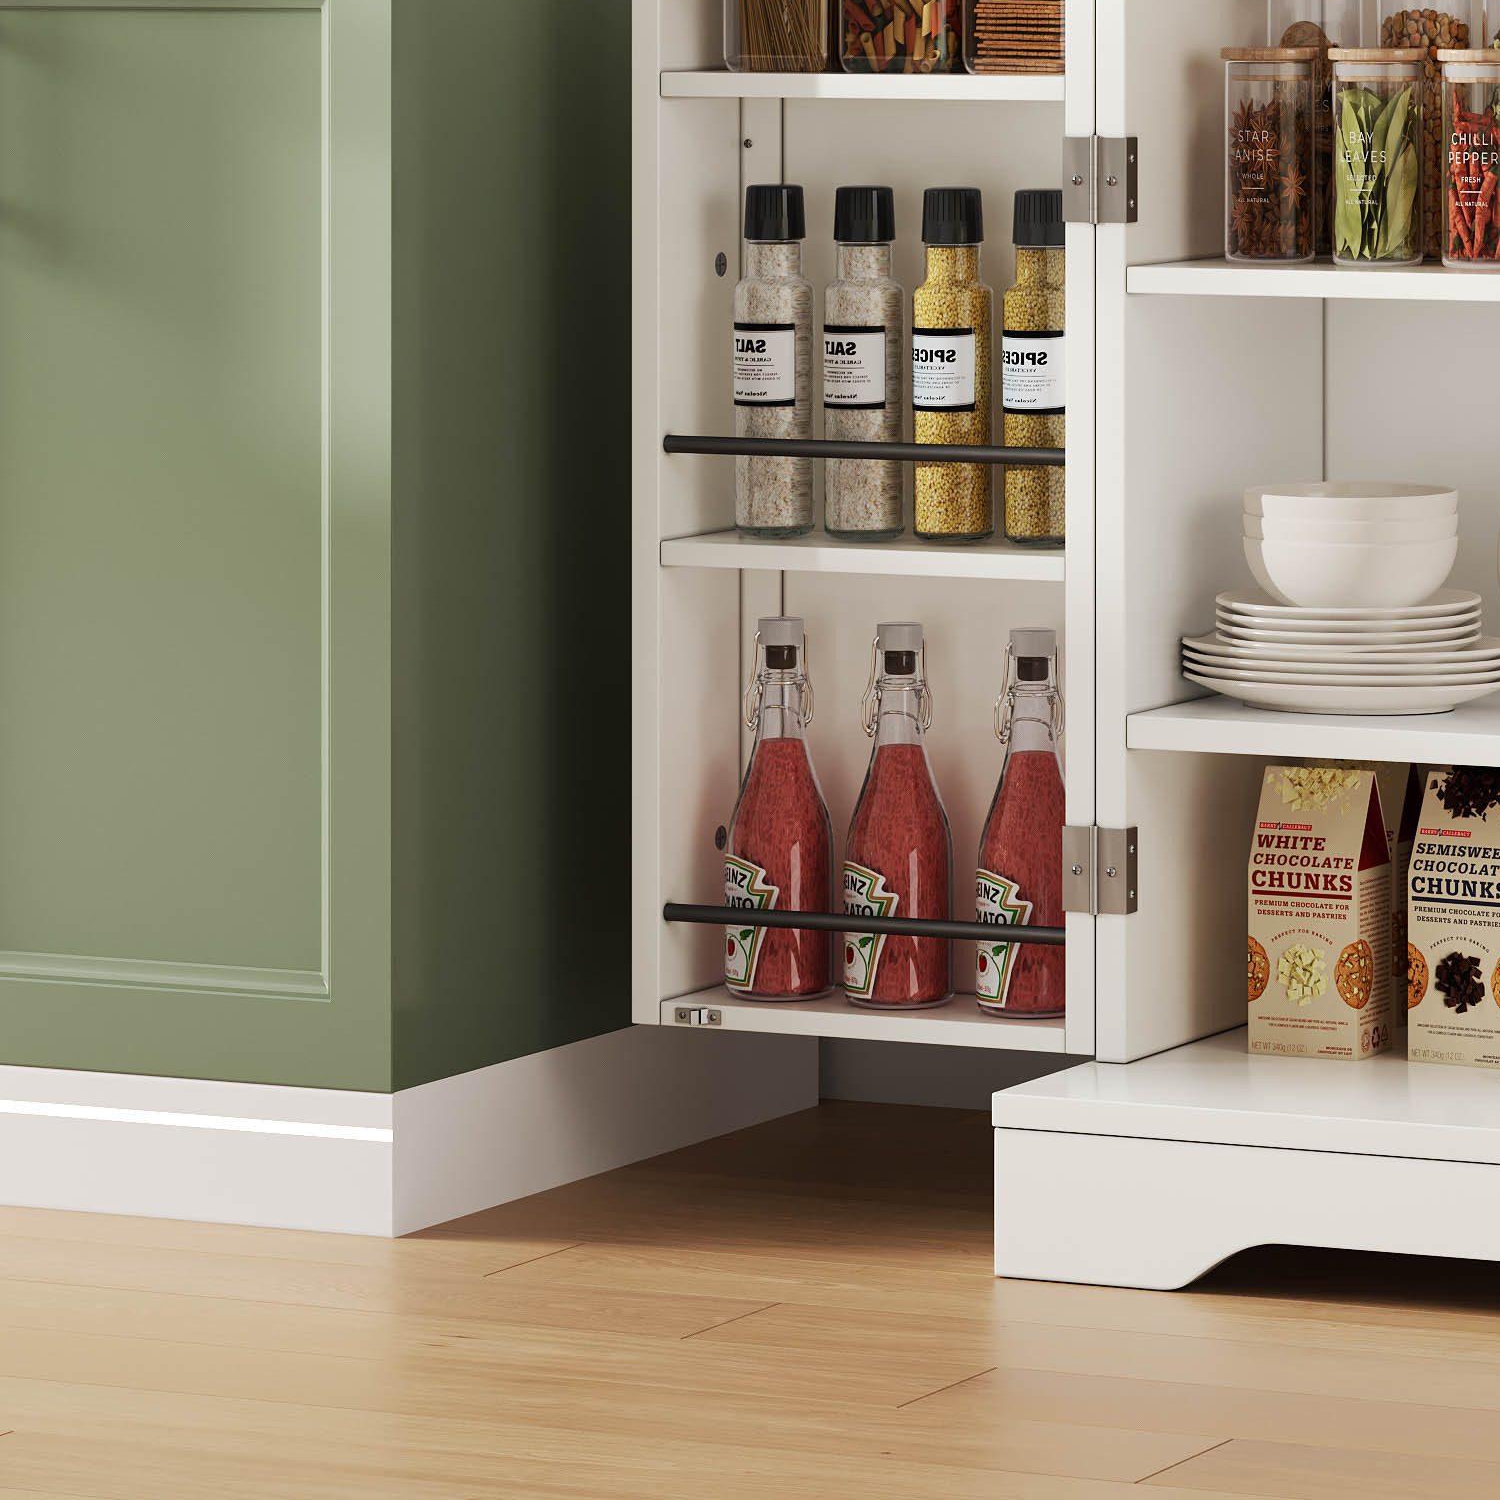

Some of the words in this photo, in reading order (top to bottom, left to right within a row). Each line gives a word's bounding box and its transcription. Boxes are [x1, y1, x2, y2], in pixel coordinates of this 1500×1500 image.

[1238, 130, 1269, 143] STAR
[1349, 132, 1374, 144] BAY
[1451, 133, 1493, 146] CHILLI
[1235, 149, 1274, 162] ANISE
[1340, 150, 1387, 163] LEAVES
[1448, 152, 1499, 165] PEPPER
[1257, 834, 1326, 852] WHITE
[1253, 853, 1355, 870] CHOCOLATE
[843, 873, 867, 896] EINZ
[1251, 870, 1353, 893] CHUNKS
[975, 881, 1001, 904] EINZ
[1254, 899, 1289, 908] PREMIUM
[1290, 901, 1333, 910] CHOCOLATE
[1335, 903, 1350, 911] FOR
[1257, 908, 1294, 917] DESSERTS
[1295, 910, 1311, 918] AND
[1312, 912, 1347, 920] PASTRIES
